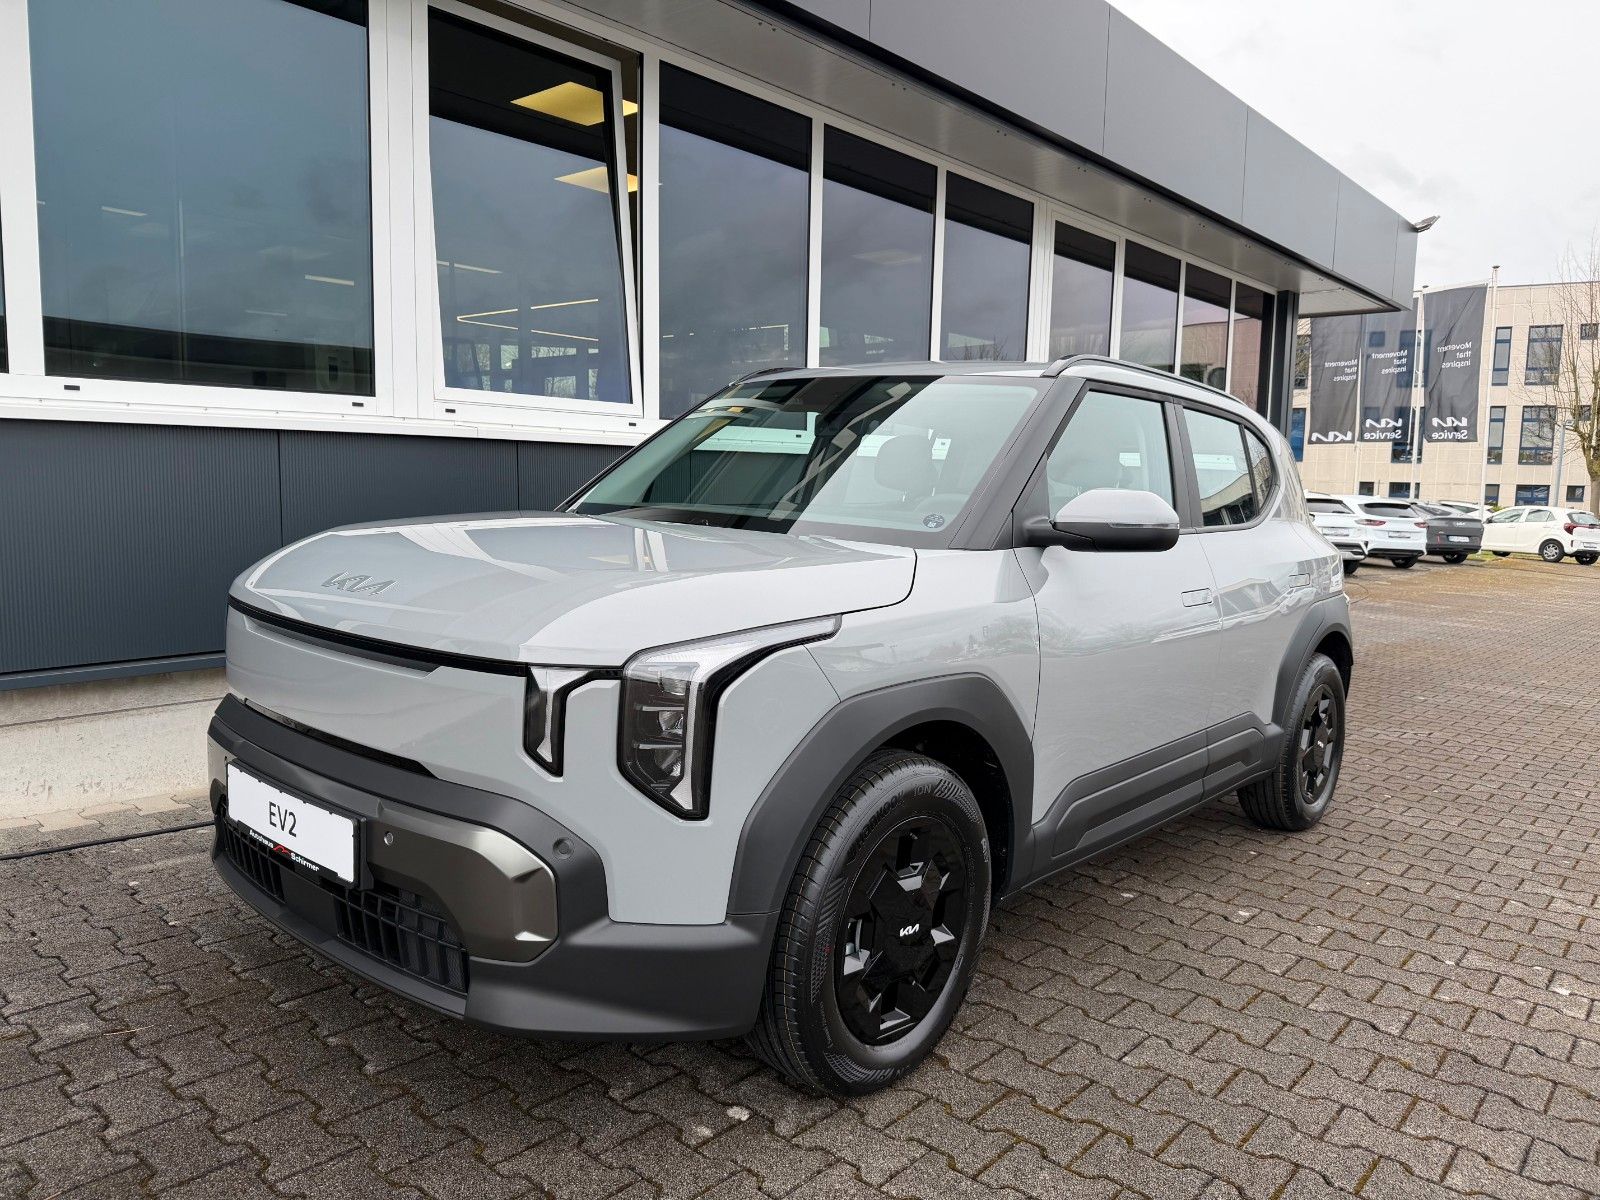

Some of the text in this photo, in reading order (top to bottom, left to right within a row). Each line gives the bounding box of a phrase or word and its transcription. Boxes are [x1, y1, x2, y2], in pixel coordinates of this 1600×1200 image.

[320, 571, 398, 596] KIA
[268, 800, 297, 838] EV2
[290, 852, 320, 873] Schirmer
[899, 923, 920, 937] KIA
